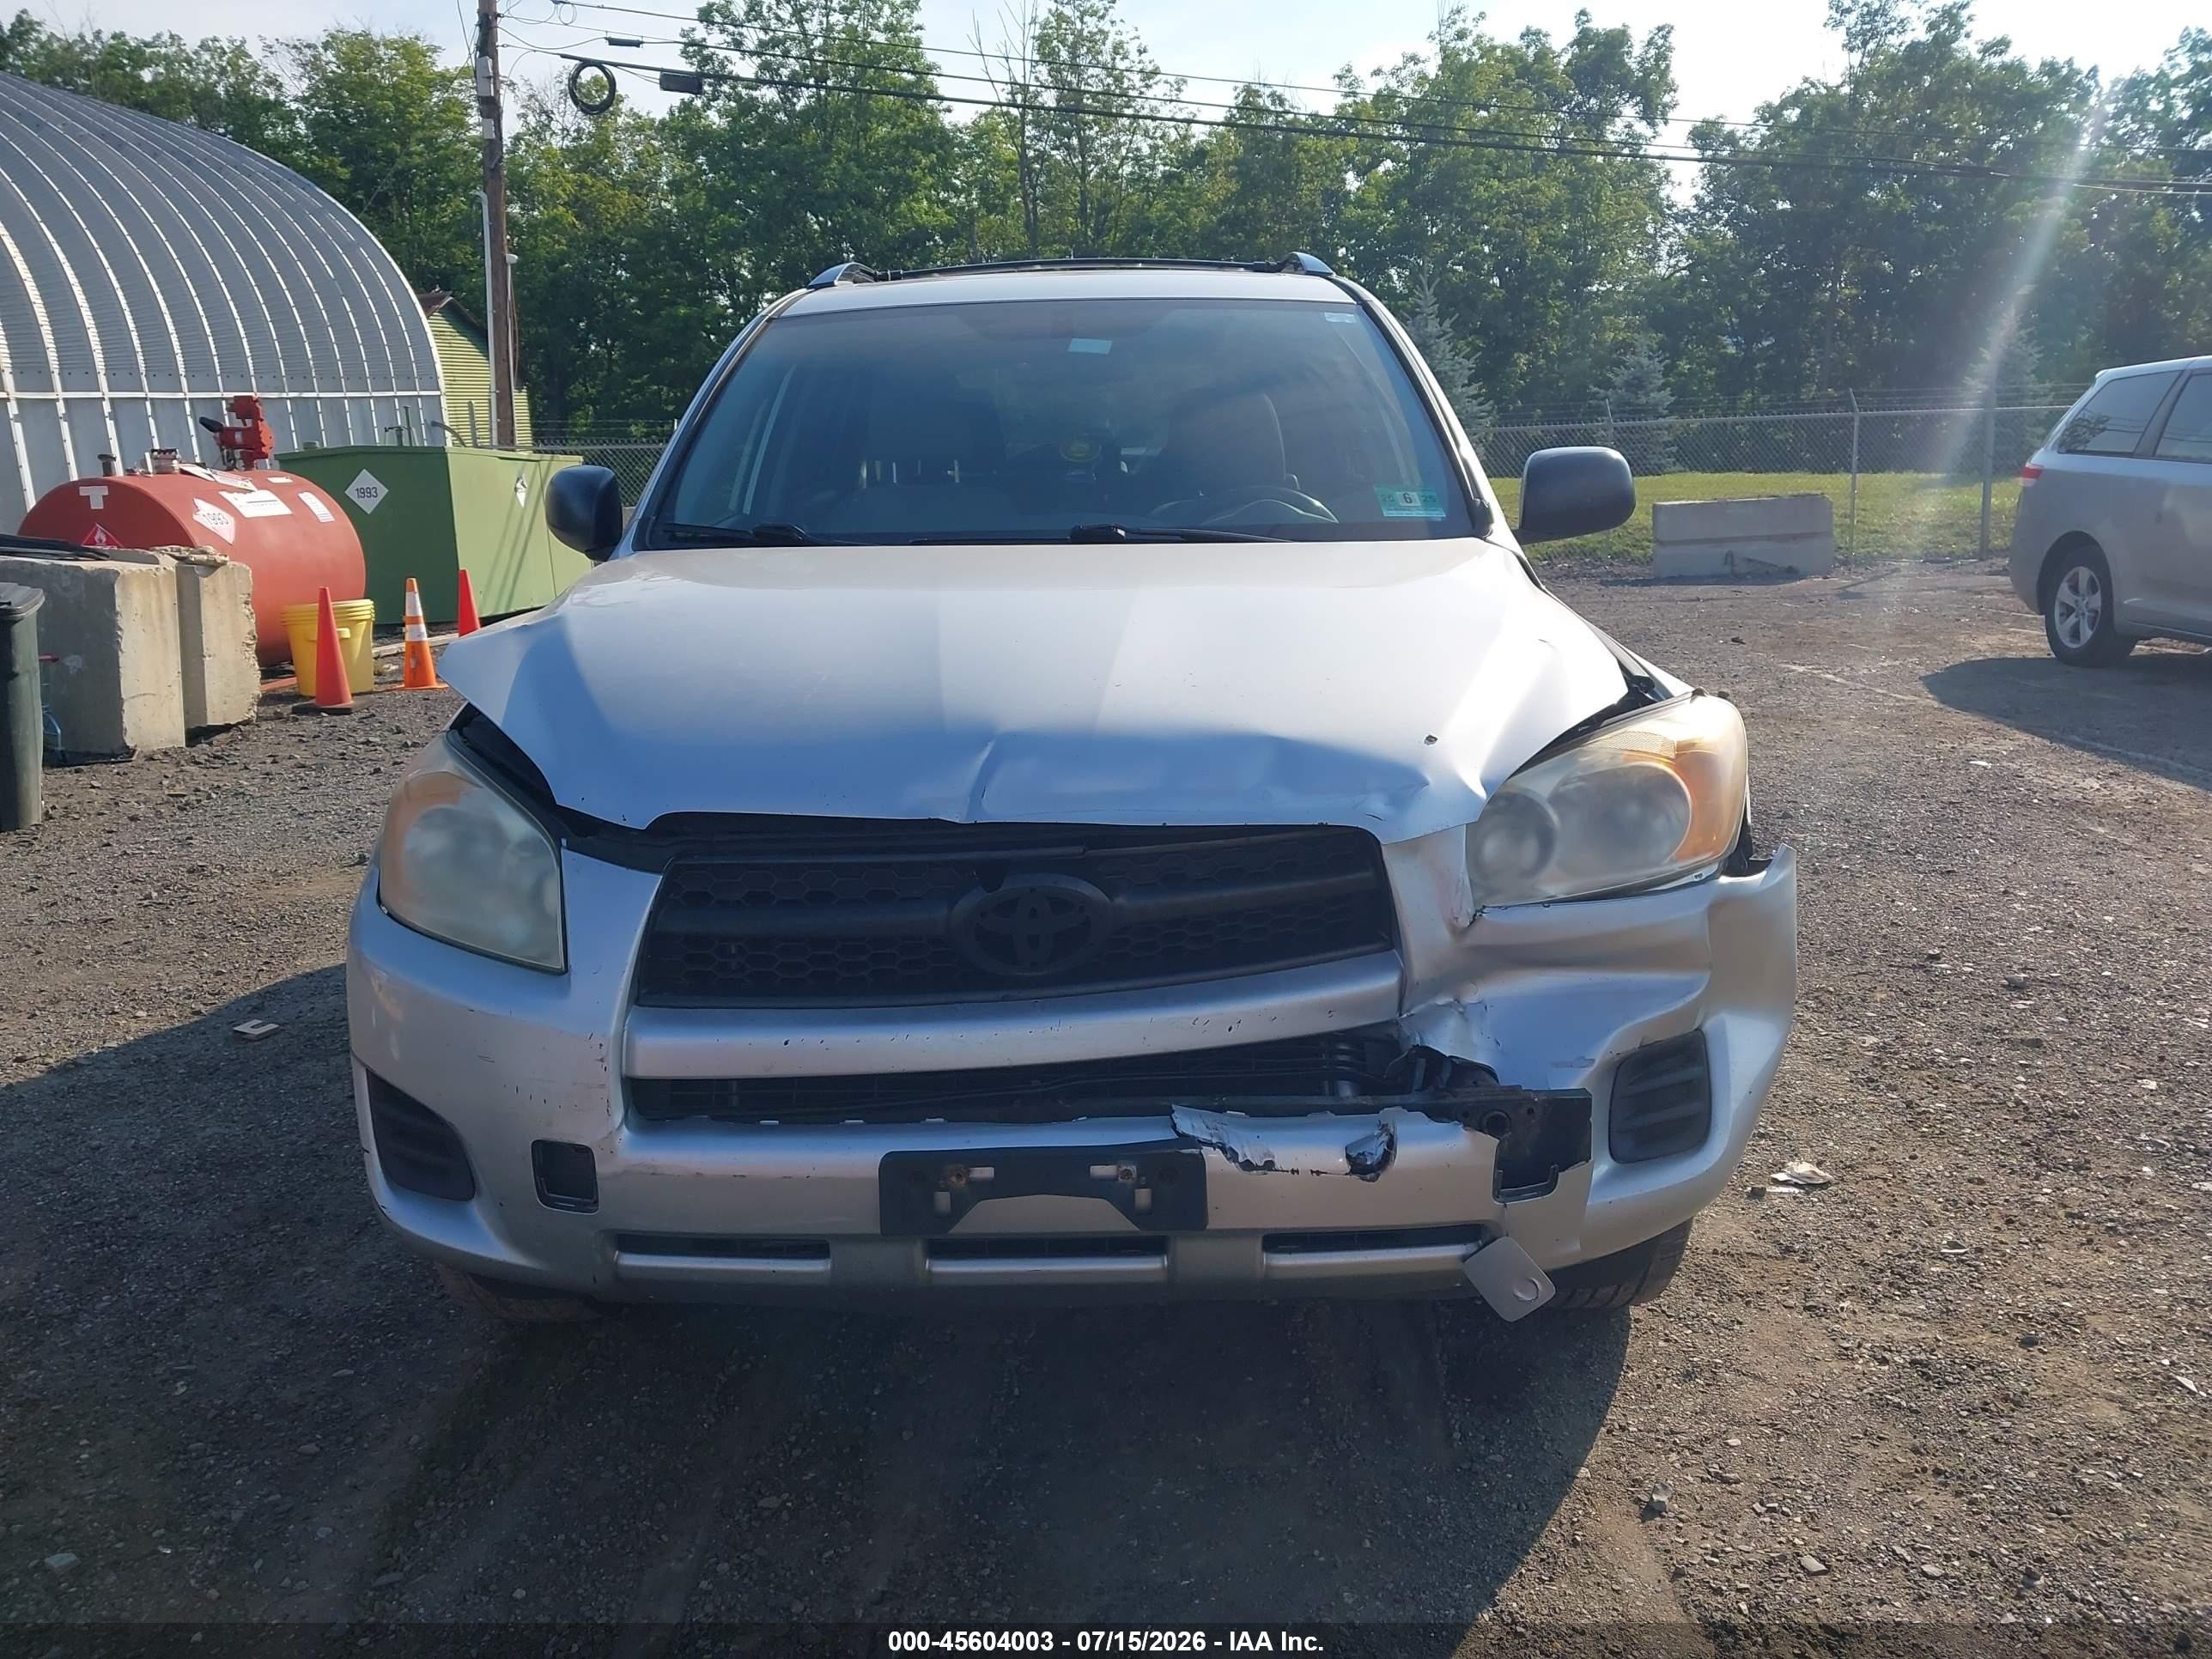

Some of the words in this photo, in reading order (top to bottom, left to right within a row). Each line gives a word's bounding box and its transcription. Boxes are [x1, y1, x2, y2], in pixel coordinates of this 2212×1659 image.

[355, 486, 379, 499] 1993
[1402, 492, 1413, 504] 6
[202, 512, 229, 526] 1993
